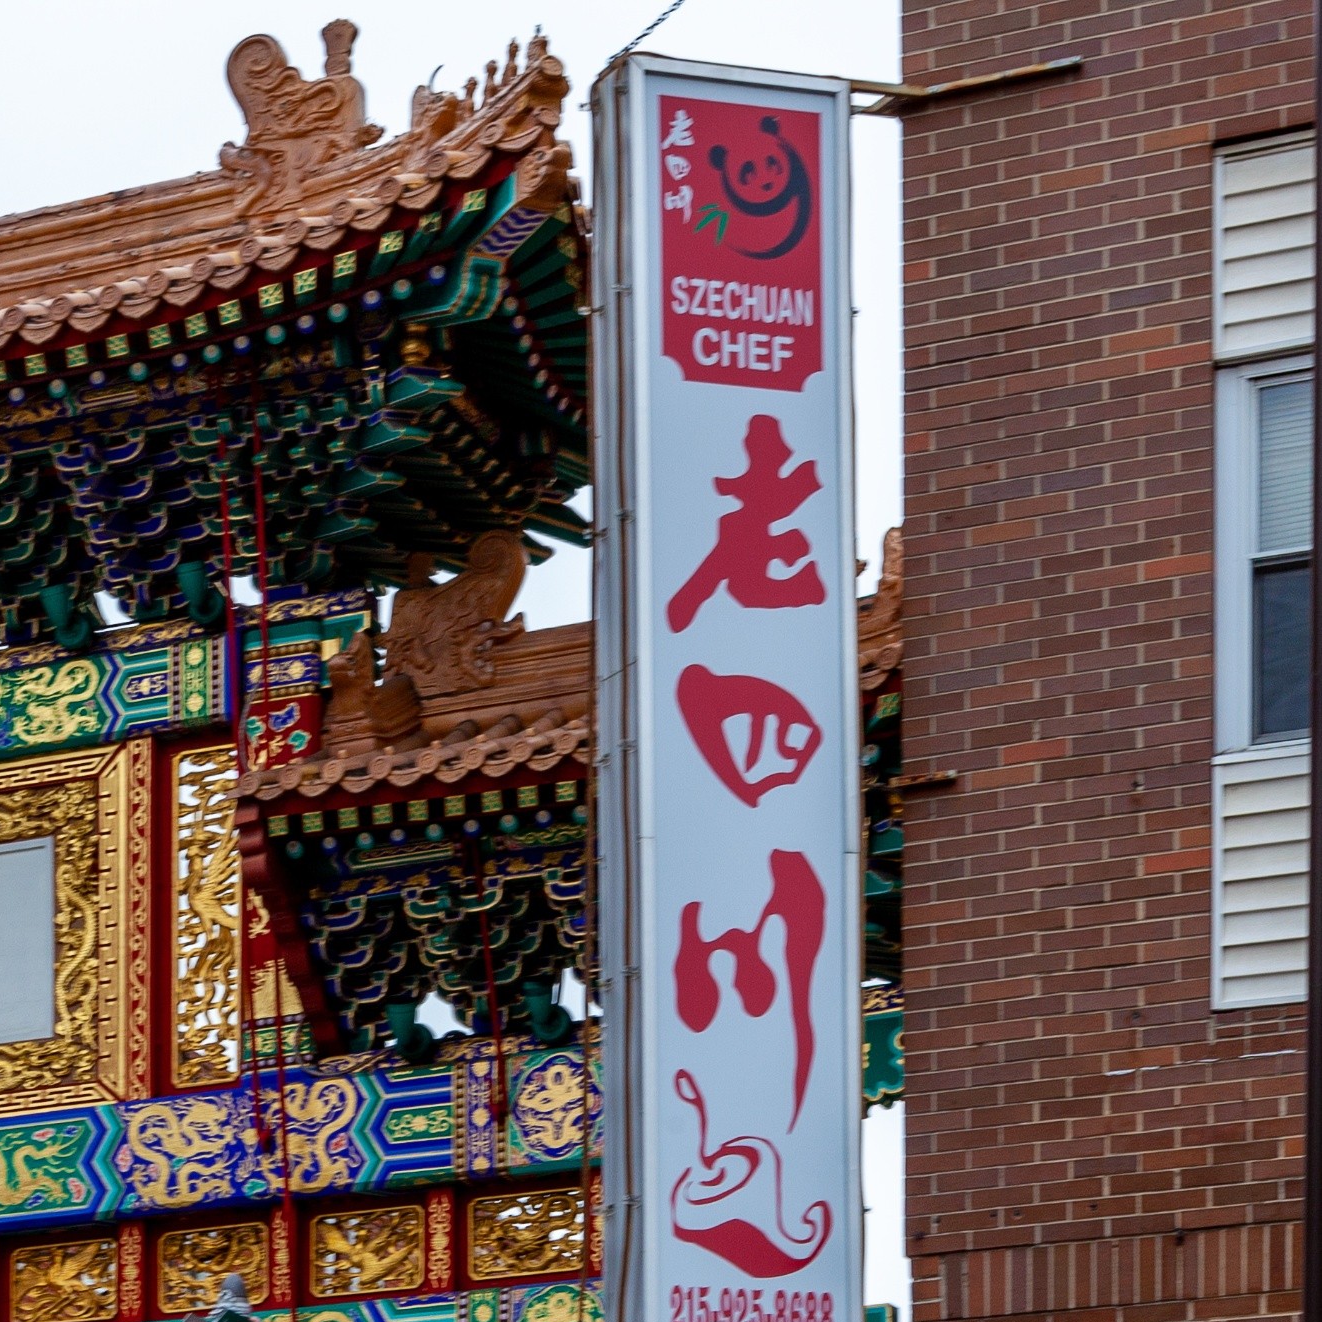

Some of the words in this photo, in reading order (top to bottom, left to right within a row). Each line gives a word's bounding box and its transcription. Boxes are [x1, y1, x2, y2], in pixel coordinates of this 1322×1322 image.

[670, 275, 815, 326] SZECHUAN
[692, 327, 795, 372] CHEF
[666, 414, 826, 1134] 老四川
